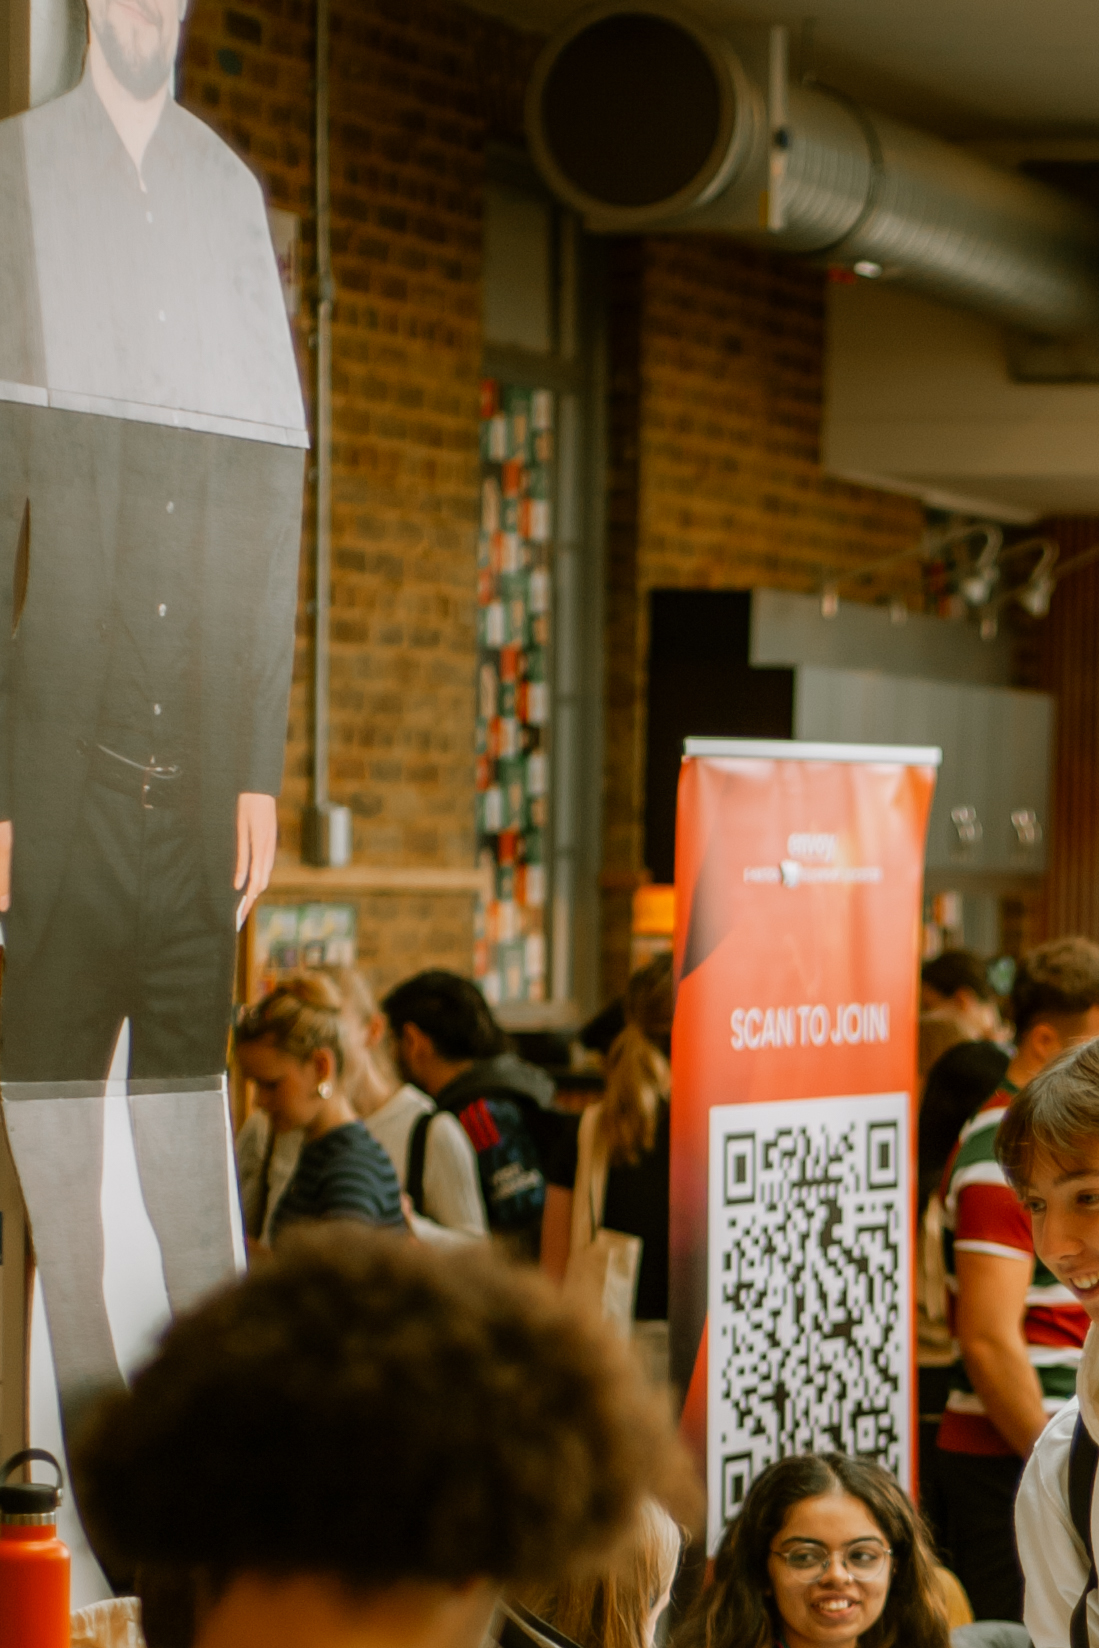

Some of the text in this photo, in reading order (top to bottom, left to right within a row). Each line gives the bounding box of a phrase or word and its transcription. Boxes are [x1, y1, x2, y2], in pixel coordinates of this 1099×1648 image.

[730, 1003, 890, 1050] SCAN TO JOIN
